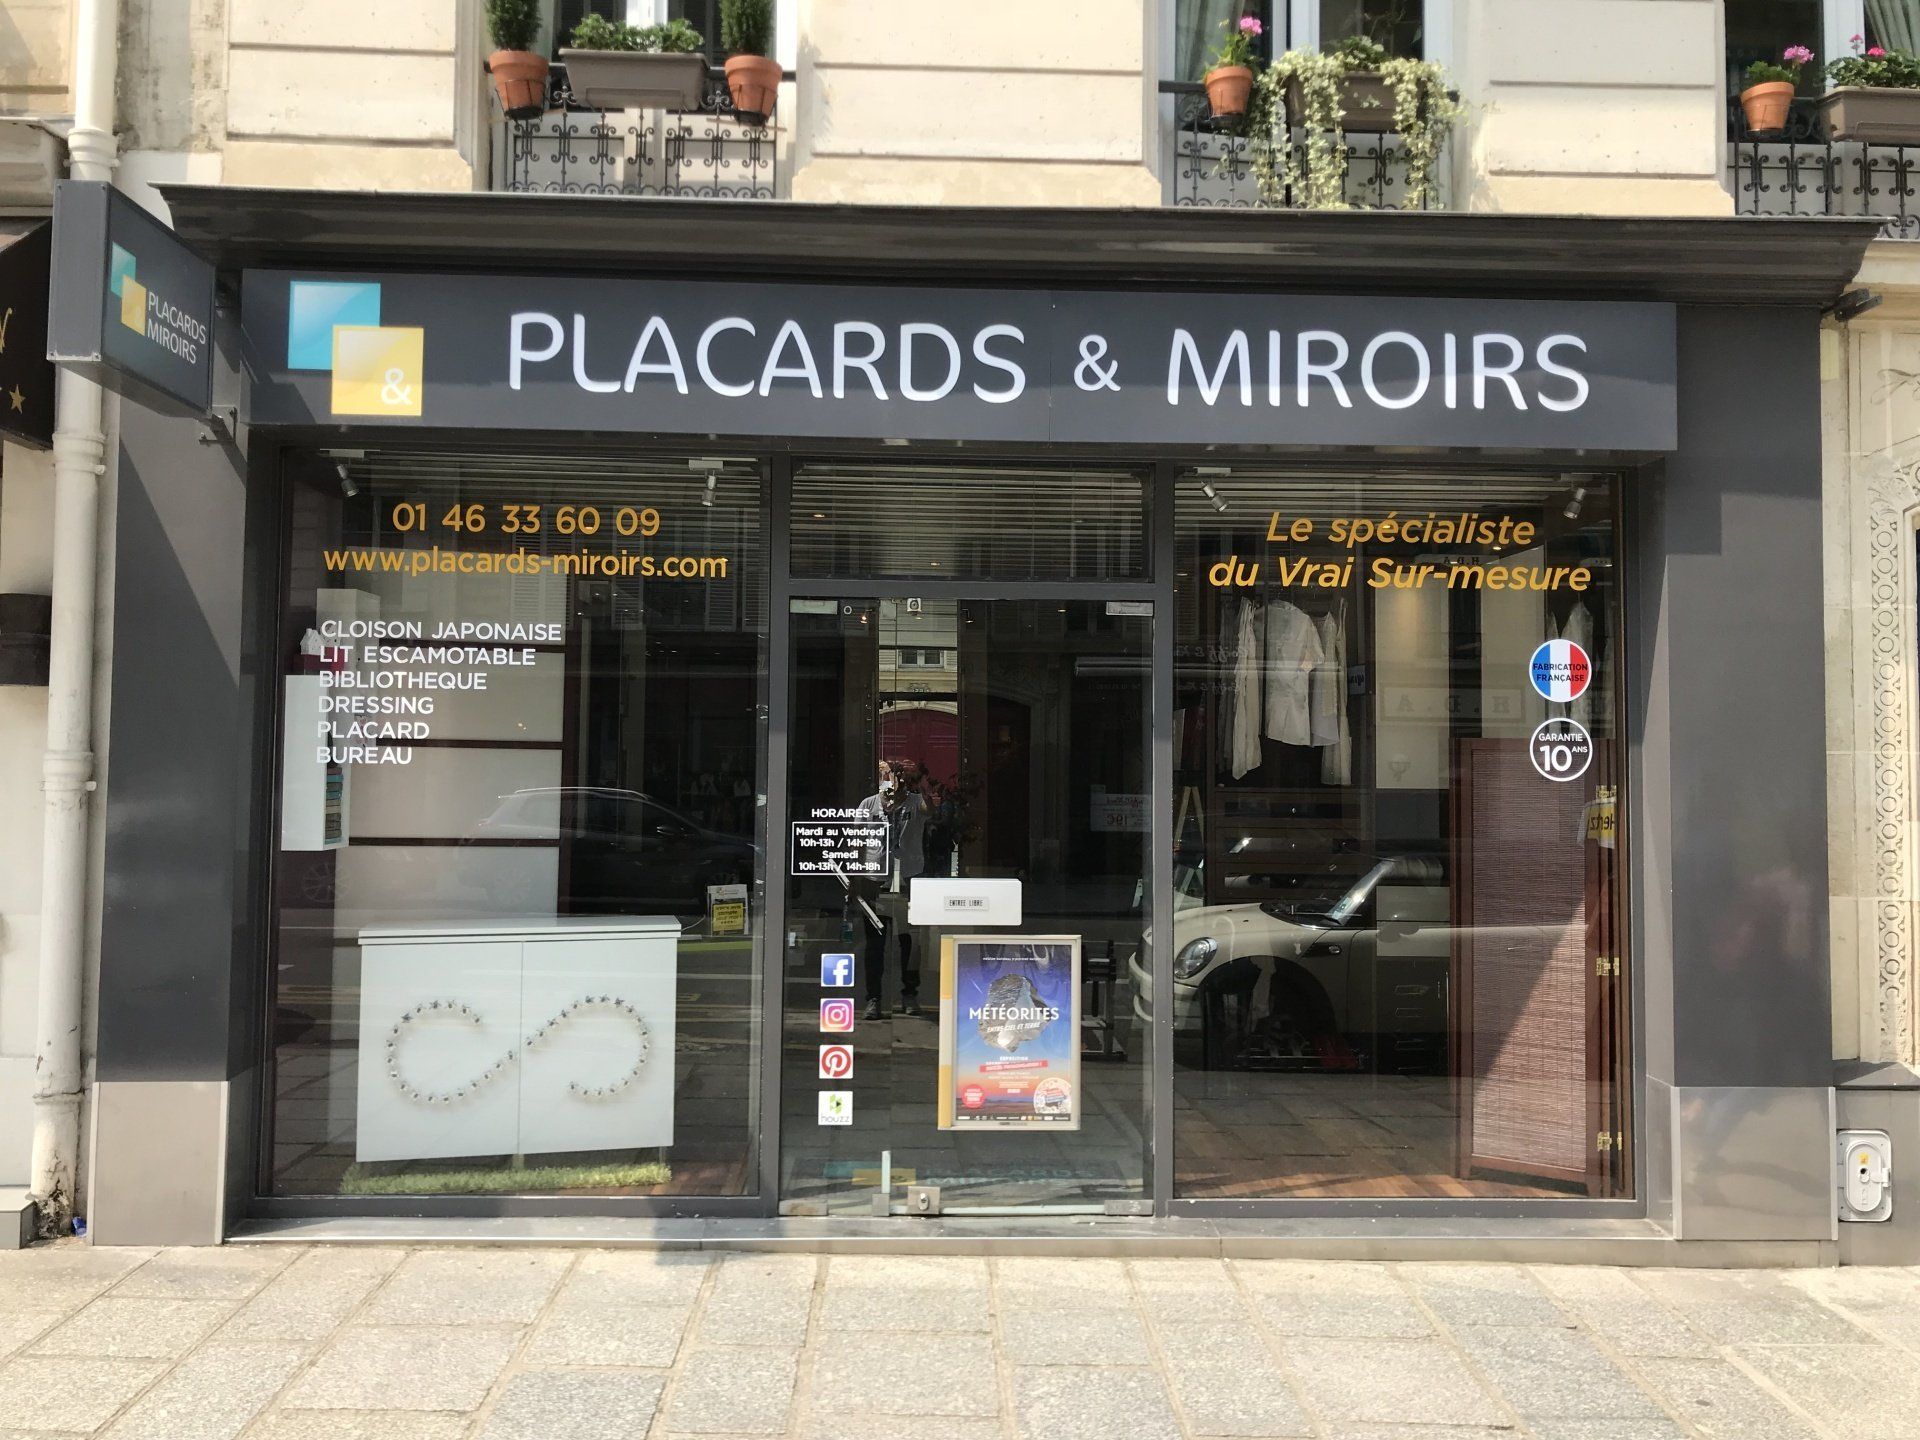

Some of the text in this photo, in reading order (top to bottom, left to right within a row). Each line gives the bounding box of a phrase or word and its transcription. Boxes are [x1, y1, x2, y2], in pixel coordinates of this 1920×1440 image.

[148, 291, 207, 345] PLACARDS
[147, 318, 197, 364] MIROIRS
[509, 312, 1589, 411] PLACARDS & MIROIRS
[380, 368, 413, 405] &
[393, 503, 660, 537] 01 46 33 60 09
[1267, 511, 1536, 549] Le spécialiste
[323, 545, 727, 578] www.placards-miroirs.com
[1208, 556, 1592, 592] du Vrai Sur-mesure
[321, 620, 562, 641] CLOISON JAPONAISE
[319, 645, 536, 666] LIT ESCAMOTABLE
[1533, 663, 1588, 671] FABRICATION
[319, 671, 487, 691] BIBLIOTHEQUE
[1536, 674, 1585, 682] FRANÇAISE
[318, 696, 434, 715] DRESSING
[317, 721, 430, 740] PLACARD
[1539, 733, 1583, 742] GARANTIE
[316, 746, 413, 766] BUREAU
[1539, 745, 1572, 772] 10
[811, 808, 870, 818] HORAIRES
[796, 827, 824, 836] Mardi
[842, 827, 885, 836] Vendredi
[800, 838, 881, 848] 10h-13h / 14h-19h
[822, 850, 859, 859] Samedi
[799, 862, 834, 871] 10h-13h
[846, 862, 880, 871] 14h-18h
[969, 1003, 1060, 1020] MÉTÉORITES
[820, 1114, 850, 1123] houzz
